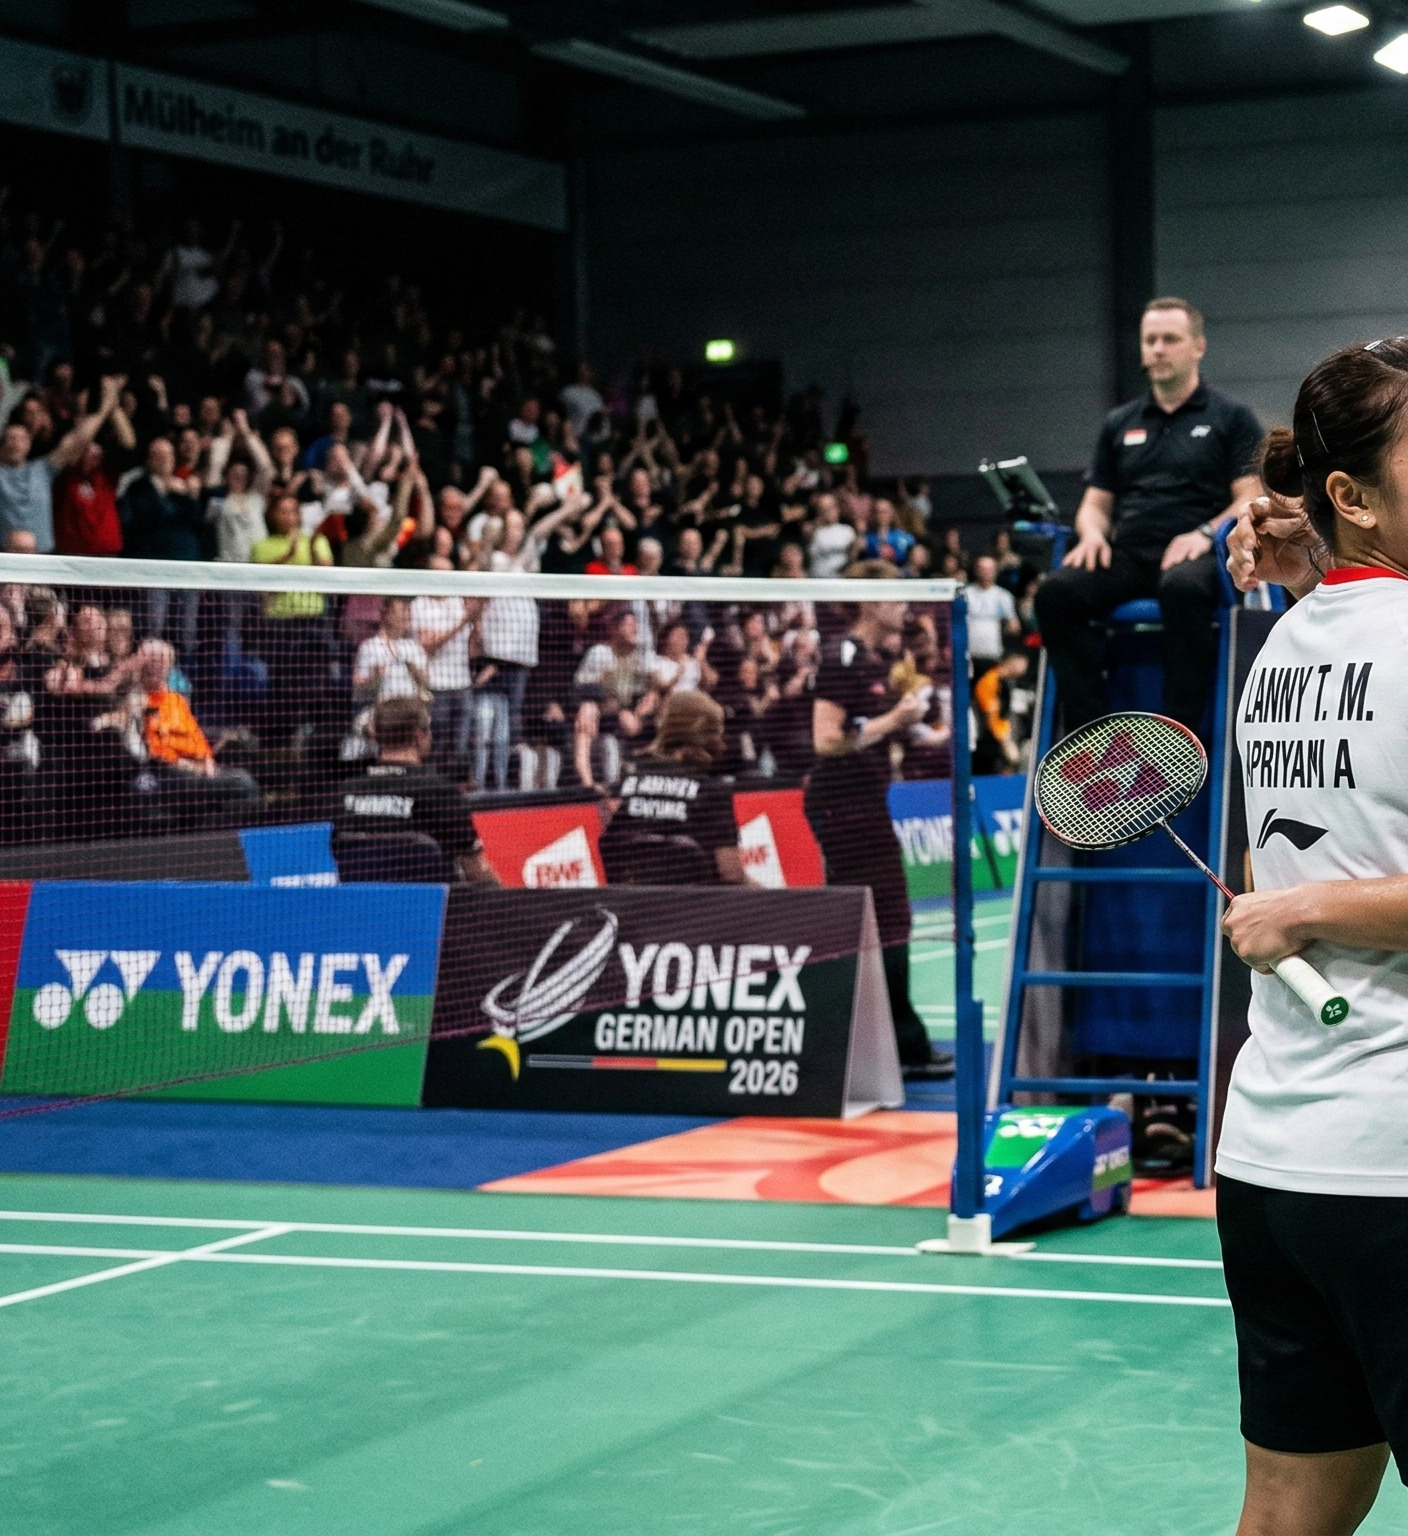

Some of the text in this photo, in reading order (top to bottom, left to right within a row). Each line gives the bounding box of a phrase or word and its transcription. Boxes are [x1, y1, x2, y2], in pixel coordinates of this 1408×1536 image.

[123, 82, 435, 184] Mülheim an der Ruhr
[1244, 662, 1374, 723] LANNY T. M.
[1333, 738, 1357, 789] A
[173, 949, 411, 1035] YONEX
[618, 941, 813, 1012] YONEX
[594, 1012, 806, 1056] GERMAN OPEN
[727, 1058, 799, 1096] 2026
